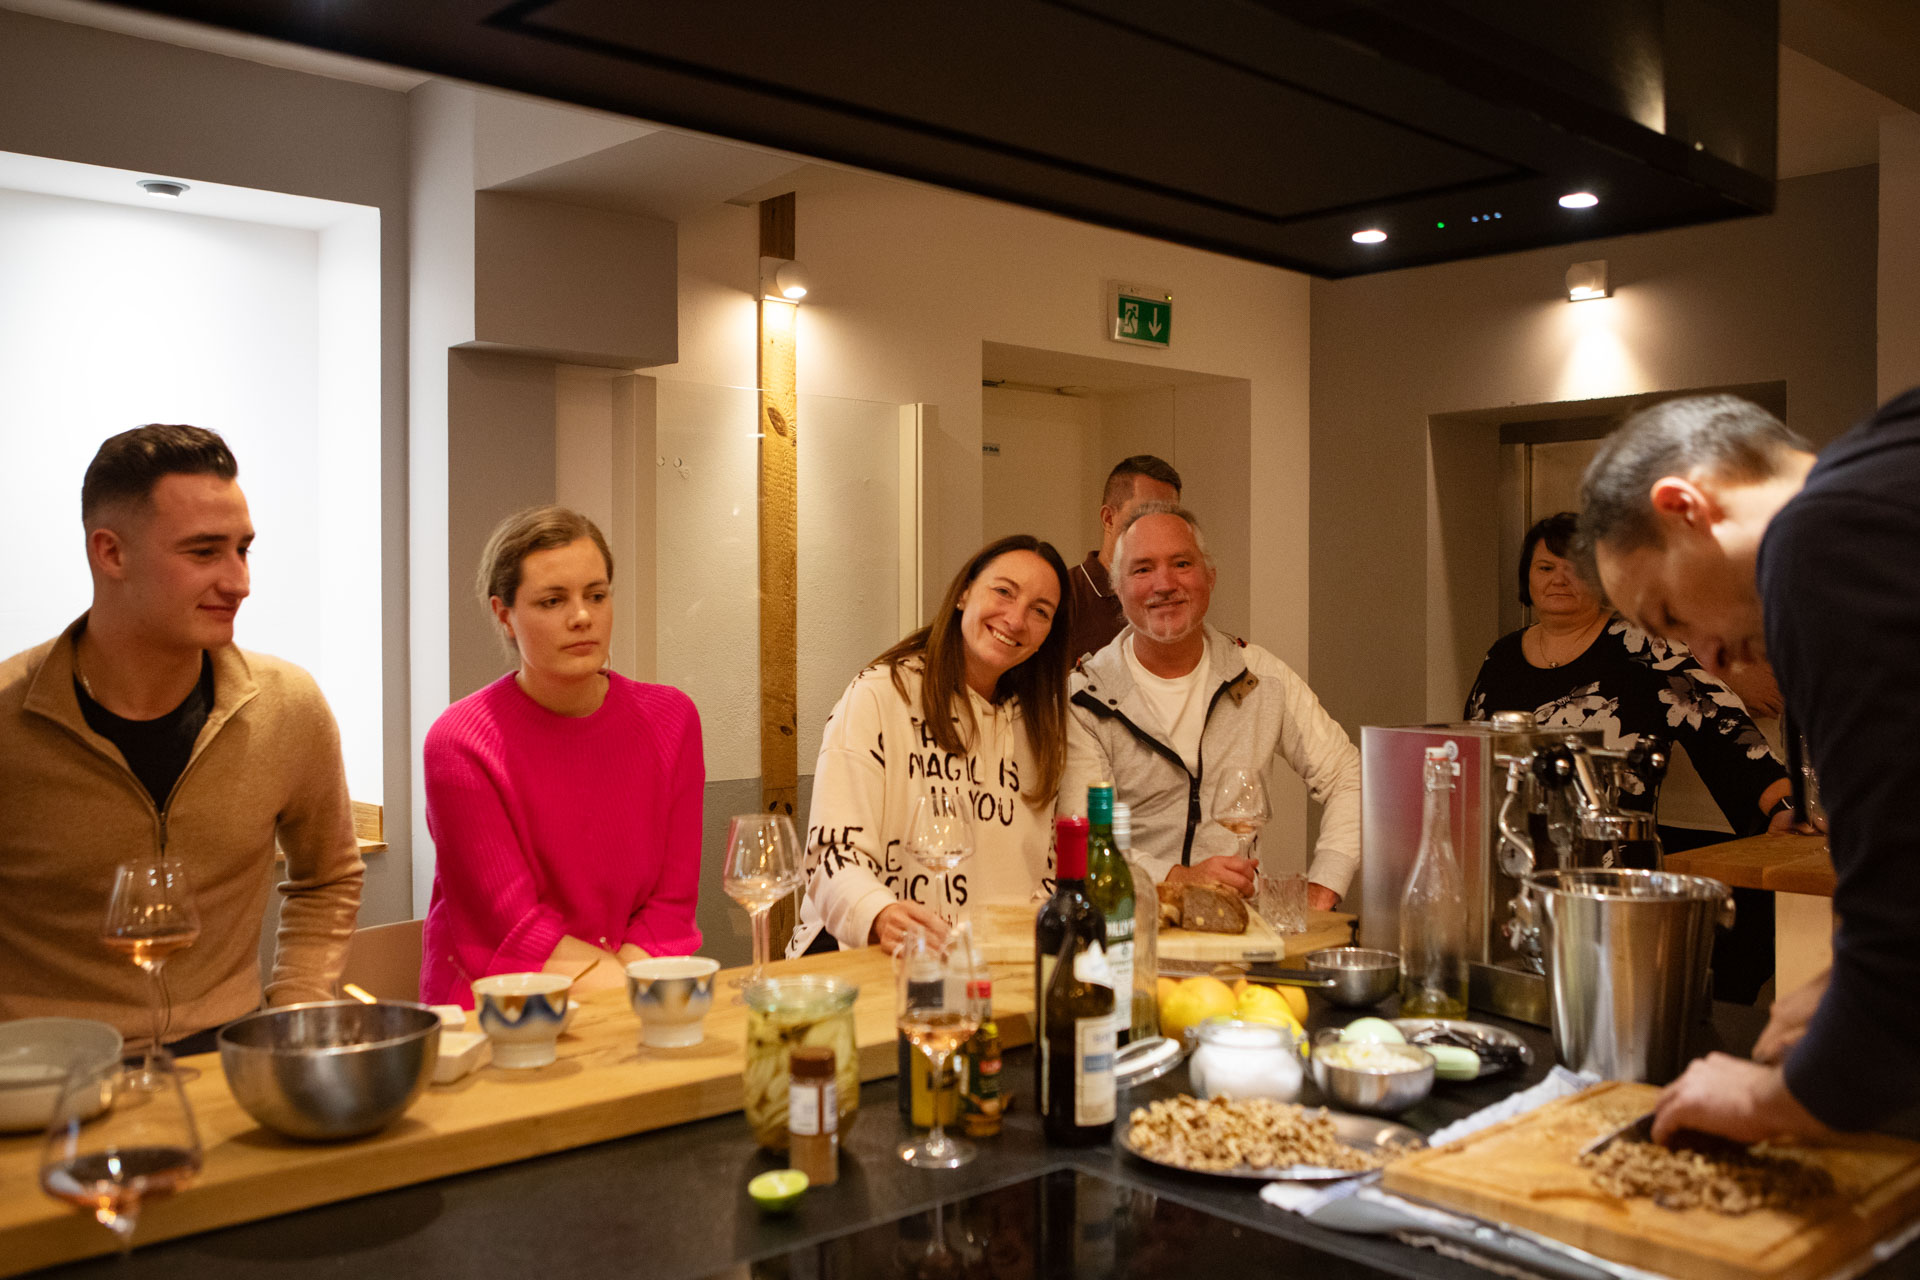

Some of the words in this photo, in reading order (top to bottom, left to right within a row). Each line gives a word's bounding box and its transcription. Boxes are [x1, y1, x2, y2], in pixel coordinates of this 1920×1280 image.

[909, 752, 984, 785] MAGIC
[999, 757, 1020, 792] IS
[968, 789, 1015, 826] YOU
[944, 873, 968, 906] IS
